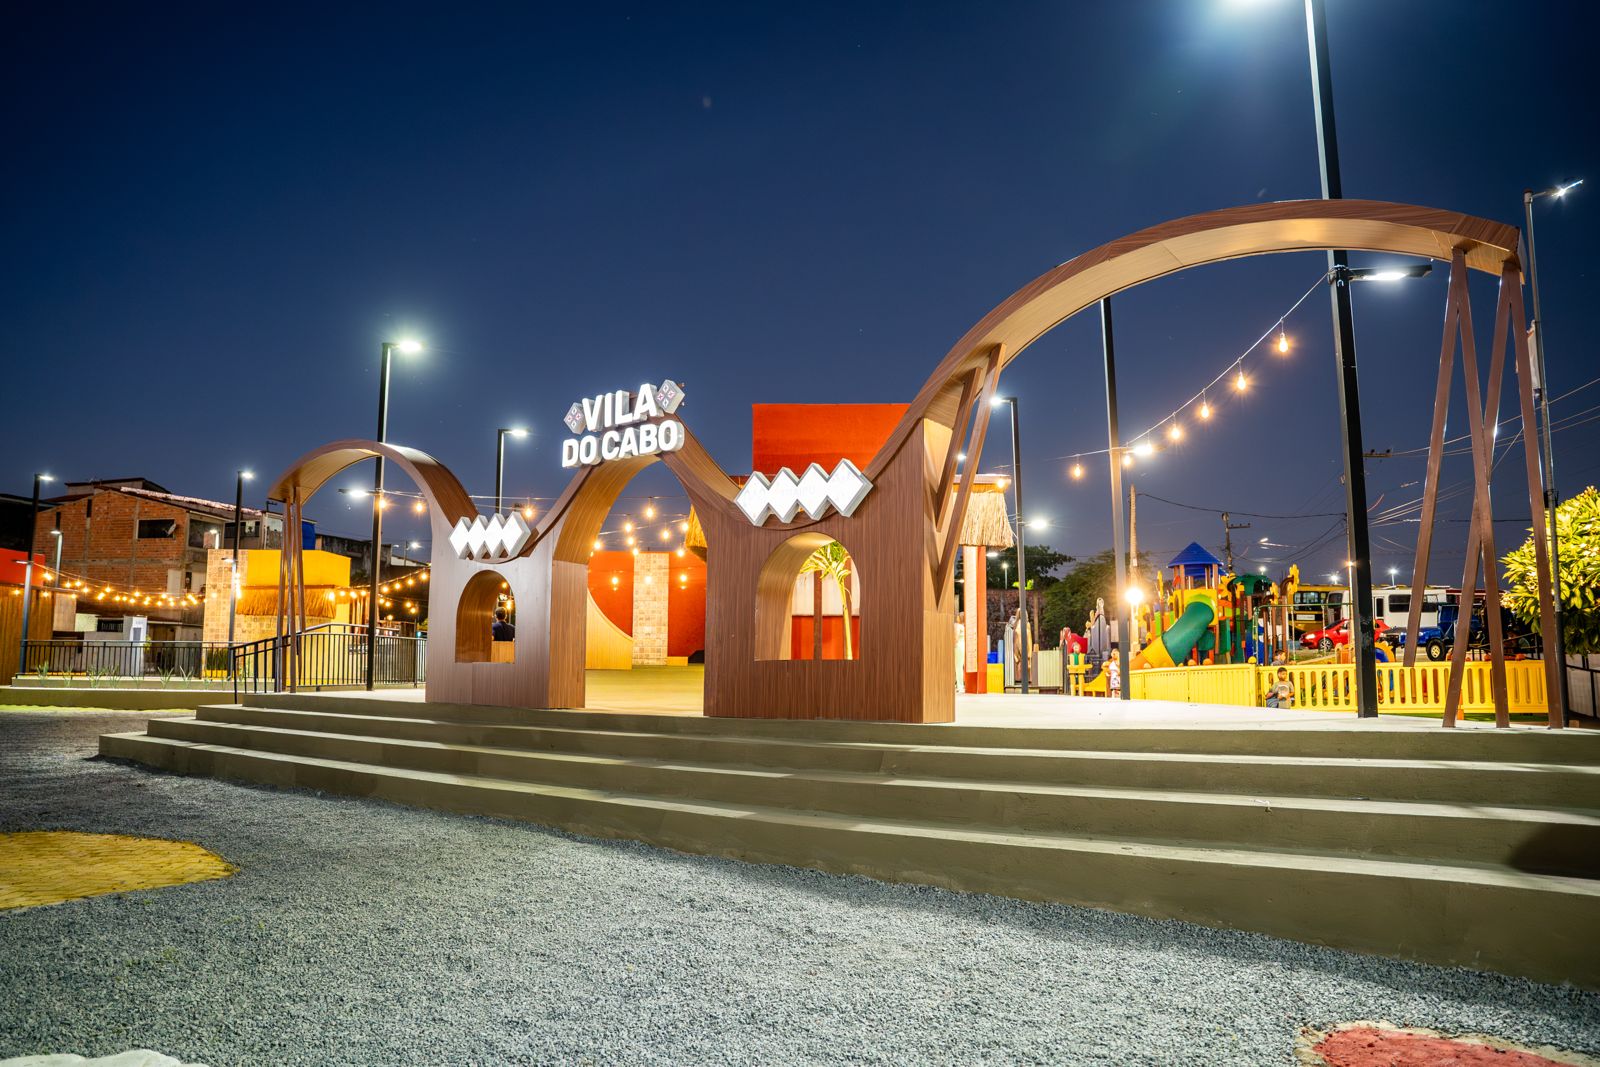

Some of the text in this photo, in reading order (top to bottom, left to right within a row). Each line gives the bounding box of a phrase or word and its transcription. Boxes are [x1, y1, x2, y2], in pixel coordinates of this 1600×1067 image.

[582, 382, 660, 431] VILA
[562, 419, 681, 468] DO CABO
